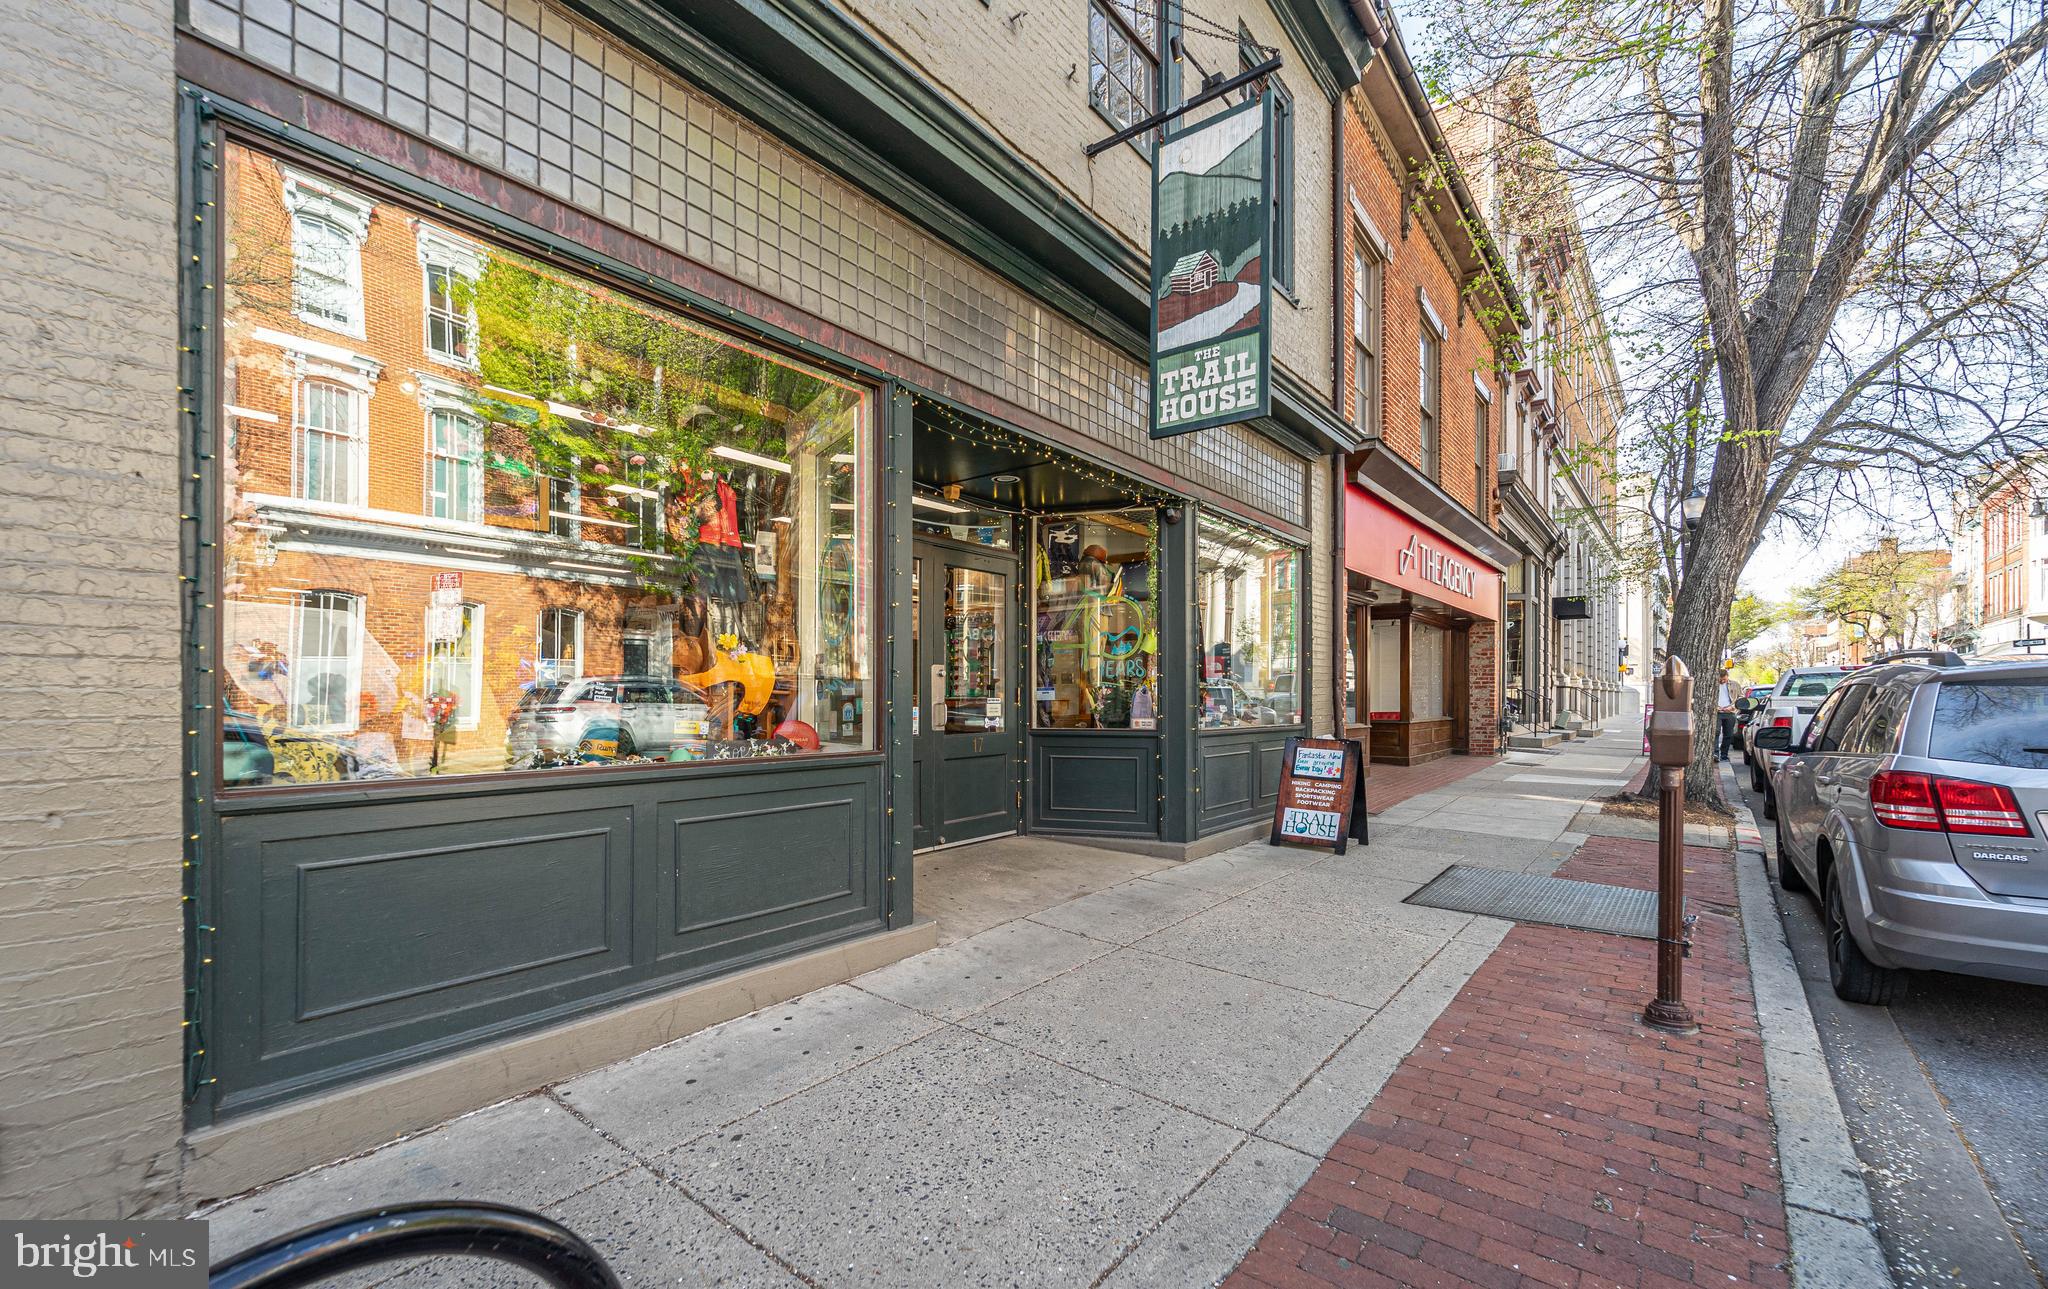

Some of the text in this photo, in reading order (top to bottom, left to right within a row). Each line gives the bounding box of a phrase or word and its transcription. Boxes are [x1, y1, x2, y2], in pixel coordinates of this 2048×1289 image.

[1194, 345, 1220, 362] THE
[1160, 351, 1257, 396] TRAIL
[1160, 378, 1257, 424] HOUSE
[1419, 543, 1442, 585] THE
[1441, 557, 1477, 600] AGENCY
[1298, 749, 1342, 760] Fantastic New
[1295, 786, 1336, 795] BACKPACKING
[1314, 782, 1342, 790] CAMPING
[1295, 793, 1335, 801] SPORTSWEAR
[1296, 799, 1330, 807] FOOTWEAR
[1291, 810, 1337, 827] TRAIL
[1283, 820, 1337, 837] HOUSE
[1973, 851, 2028, 862] DARCARS
